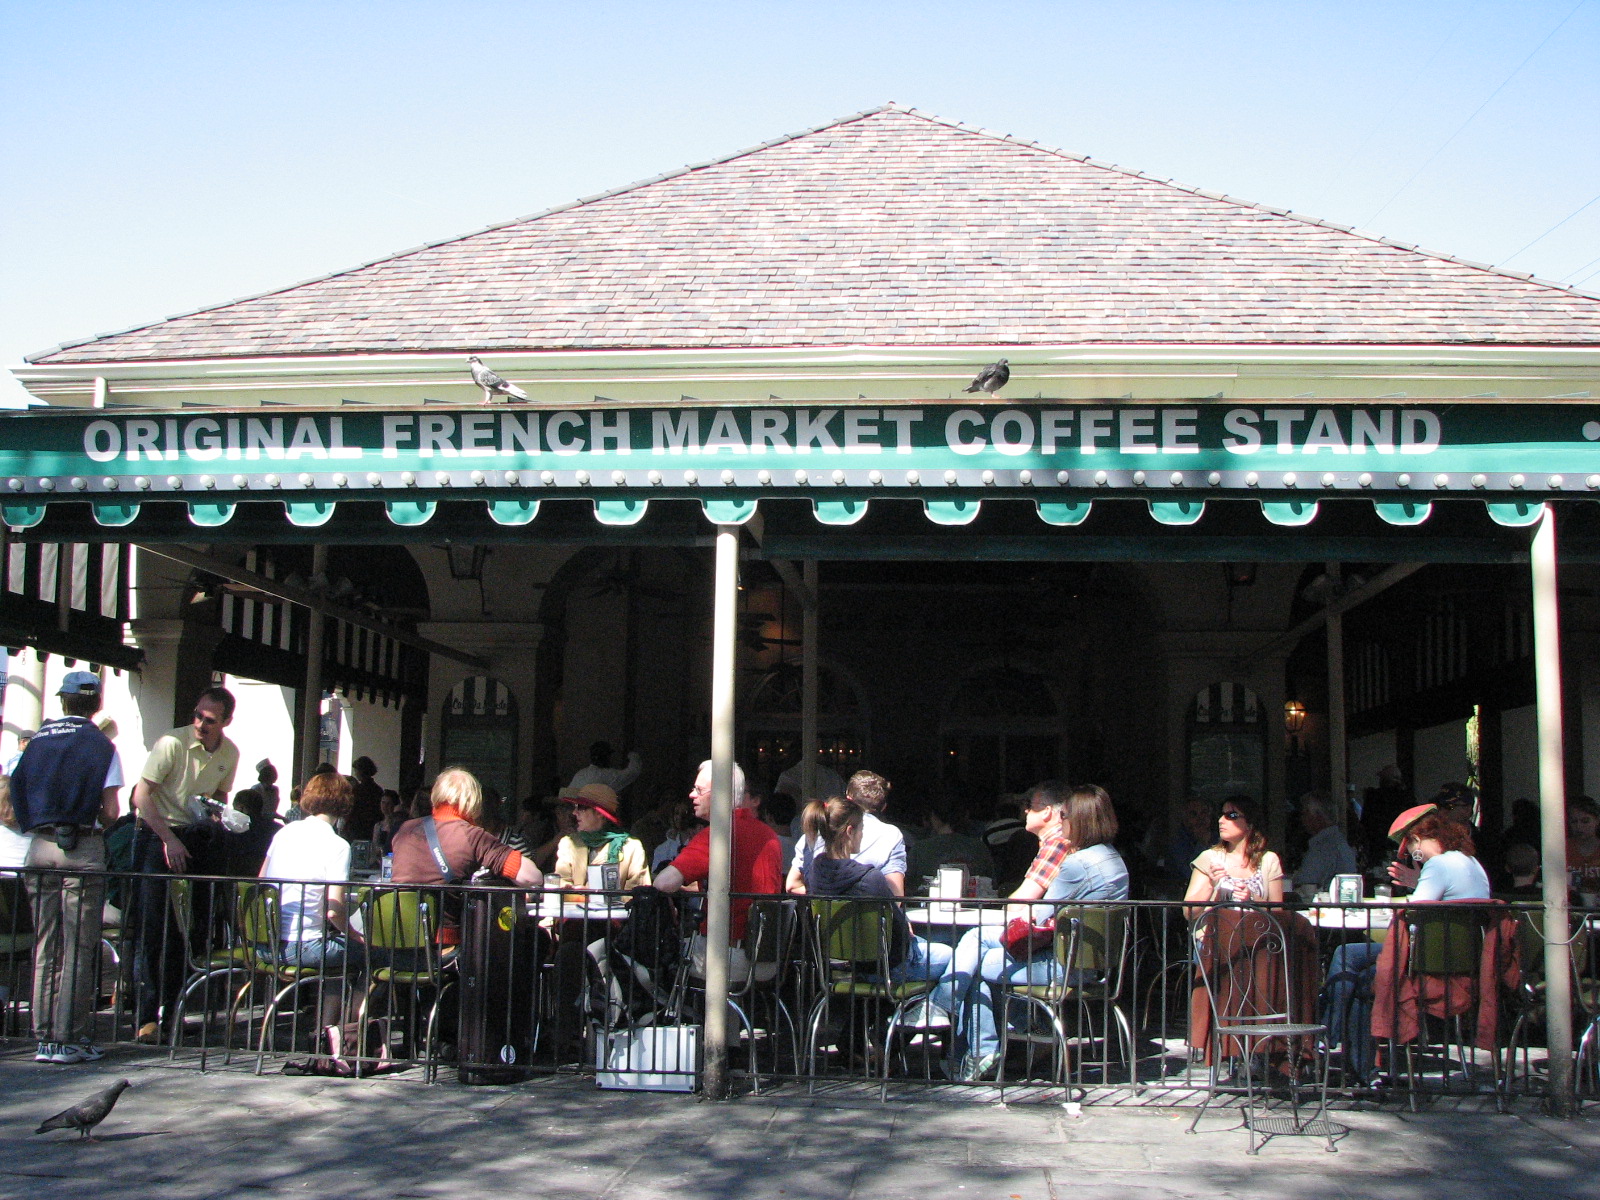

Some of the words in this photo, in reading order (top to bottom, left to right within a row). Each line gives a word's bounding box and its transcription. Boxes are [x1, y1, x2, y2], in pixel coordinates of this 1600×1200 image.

[83, 417, 362, 462] ORIGINAL
[382, 411, 631, 458] FRENCH
[651, 409, 923, 455] MARKET
[944, 409, 1199, 456] COFFEE
[1222, 408, 1441, 456] STAND
[433, 846, 449, 874] Canon
